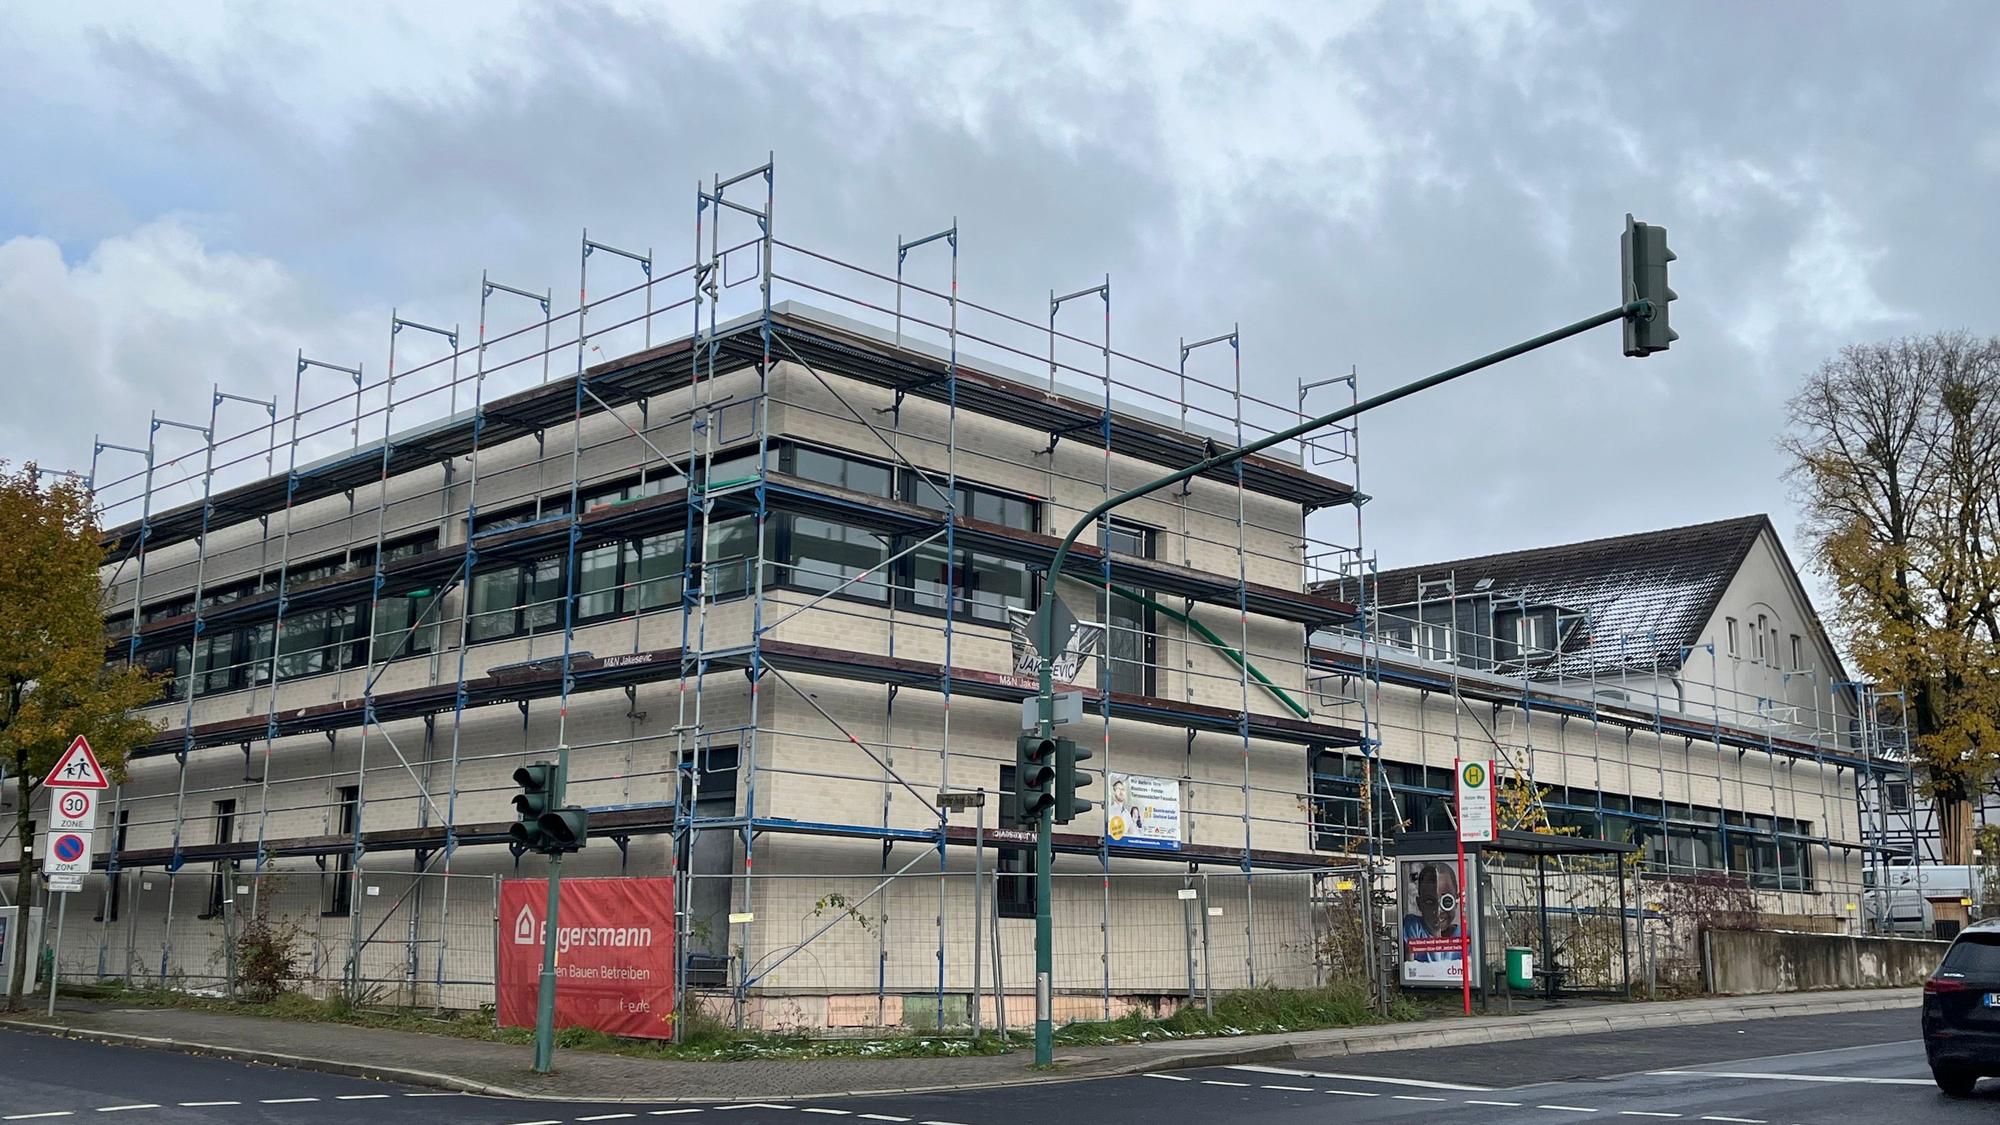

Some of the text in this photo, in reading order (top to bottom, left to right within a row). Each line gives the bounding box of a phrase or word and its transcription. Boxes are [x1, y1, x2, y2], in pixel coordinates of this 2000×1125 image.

[999, 675, 1018, 687] M&N
[1469, 769, 1479, 783] H
[65, 798, 83, 812] 30
[61, 820, 85, 828] ZONE
[539, 920, 652, 954] Egersmann
[569, 964, 599, 979] Bauen
[600, 964, 650, 980] Betreiben
